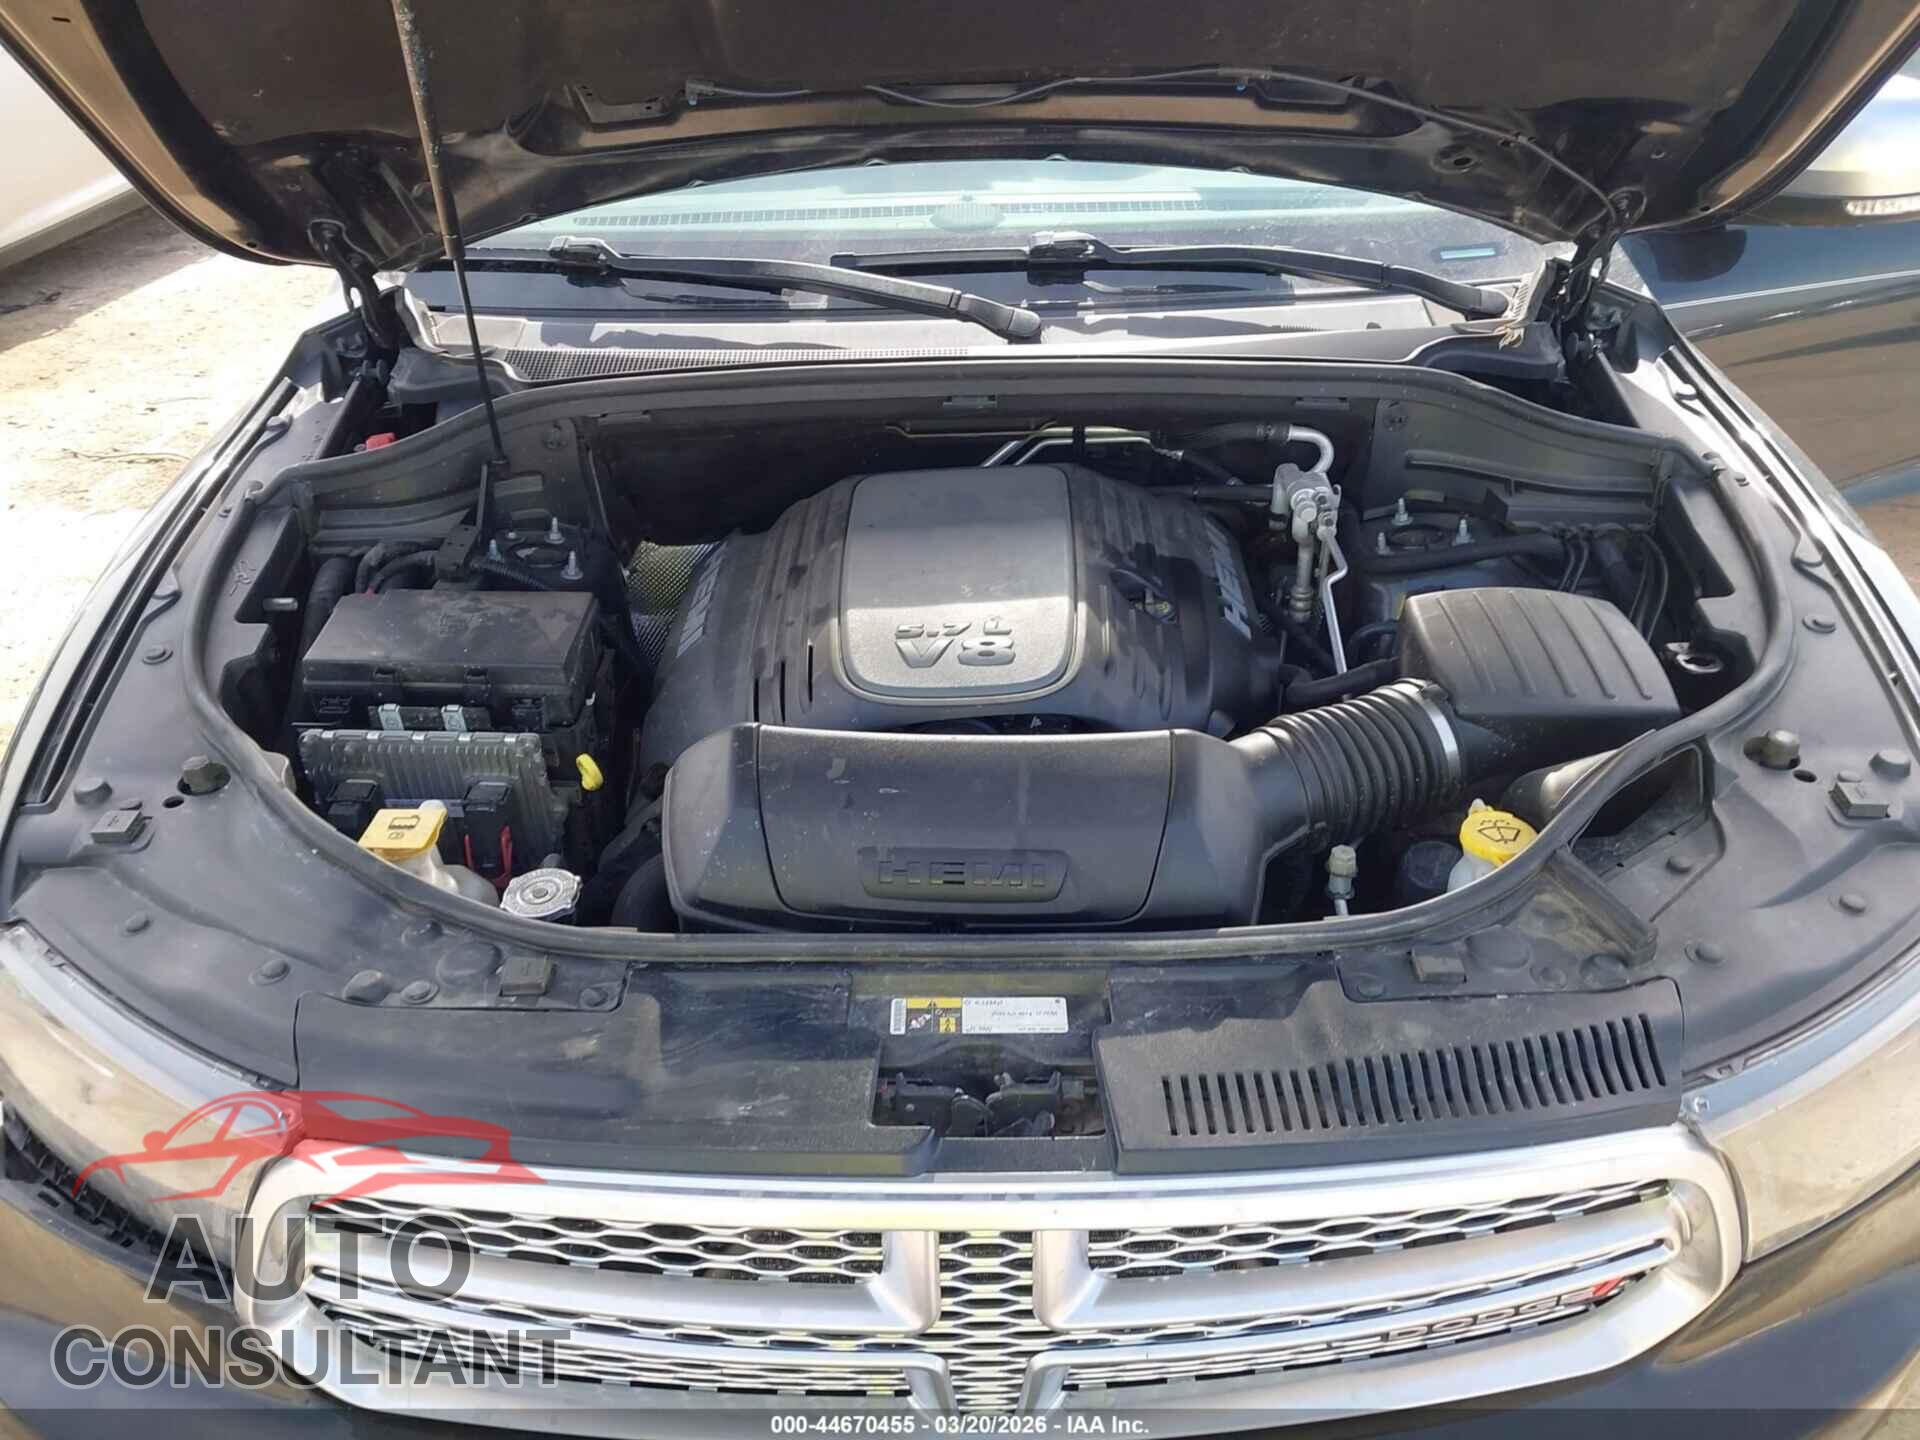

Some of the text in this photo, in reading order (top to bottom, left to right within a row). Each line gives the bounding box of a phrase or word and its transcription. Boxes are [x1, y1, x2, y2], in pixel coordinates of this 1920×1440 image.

[895, 623, 972, 639] 5.7
[895, 637, 1016, 668] V8
[878, 860, 1046, 887] HEMI
